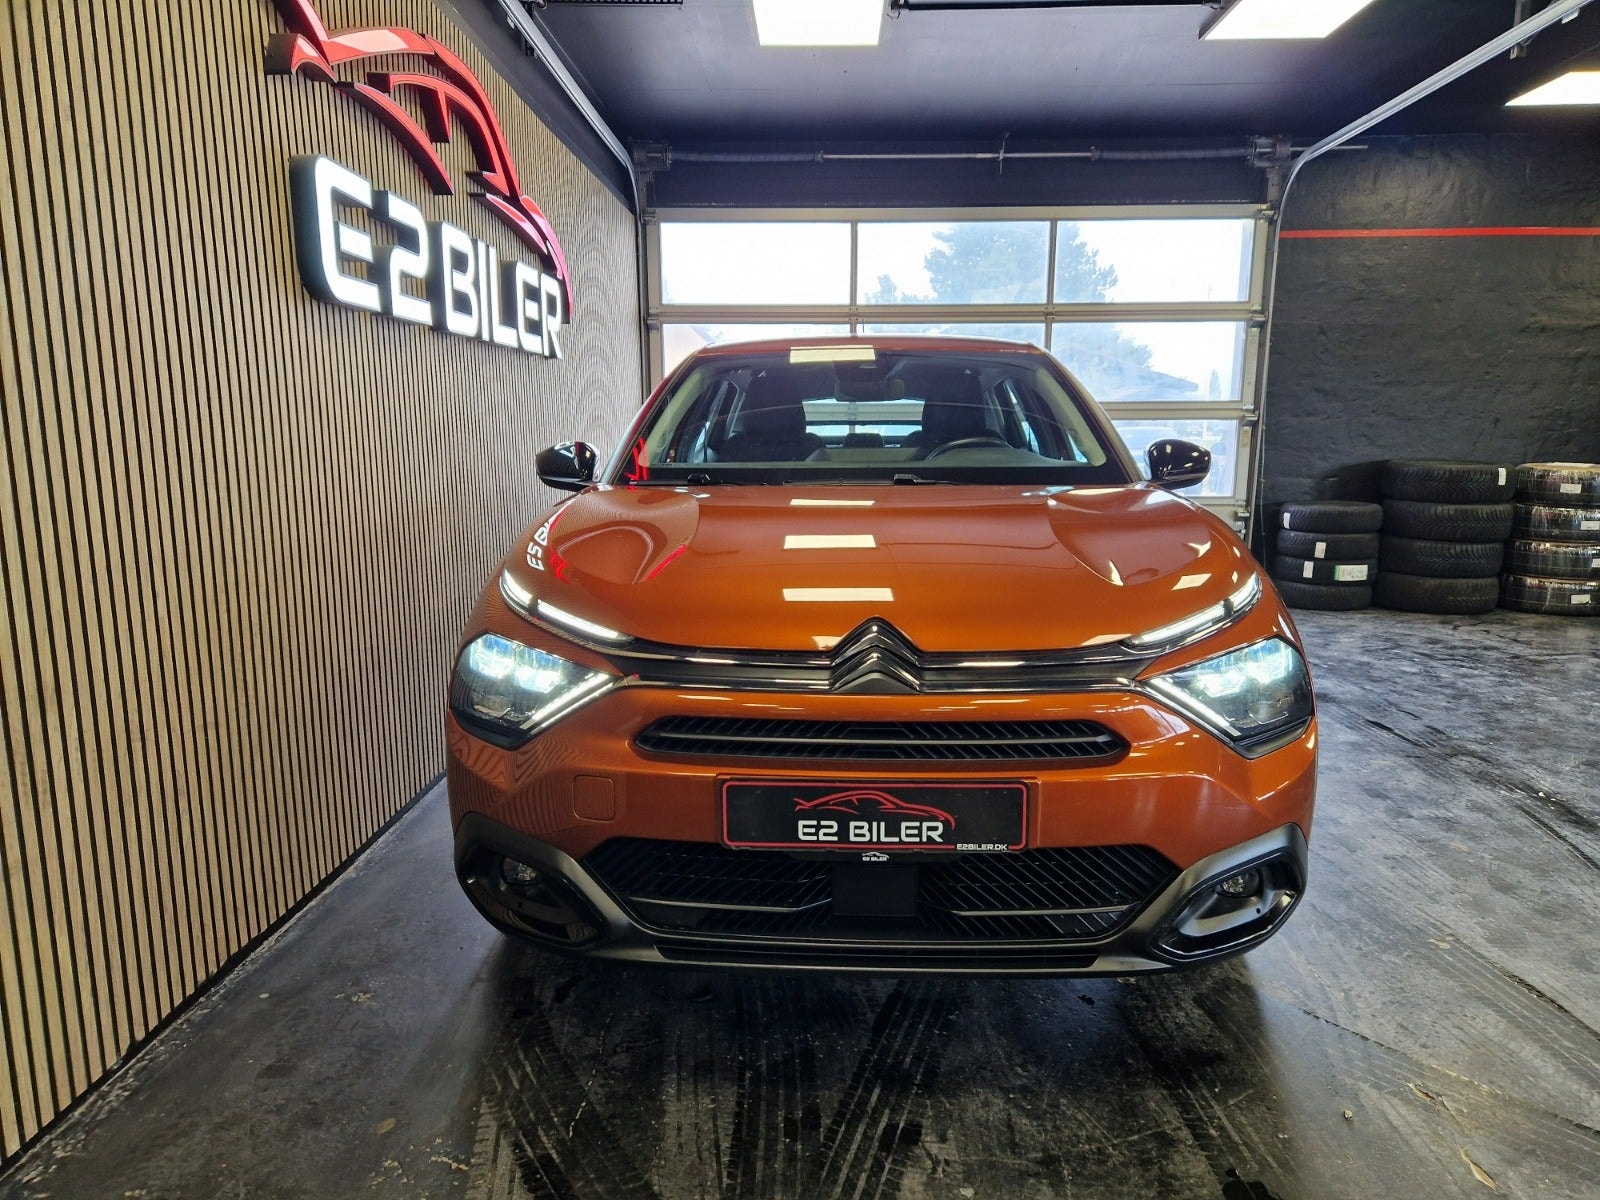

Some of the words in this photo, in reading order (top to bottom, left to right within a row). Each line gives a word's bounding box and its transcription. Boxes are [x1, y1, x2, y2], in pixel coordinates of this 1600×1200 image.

[312, 153, 434, 327] E2
[439, 219, 564, 361] BILER
[797, 820, 839, 841] E2
[849, 821, 944, 843] BILER
